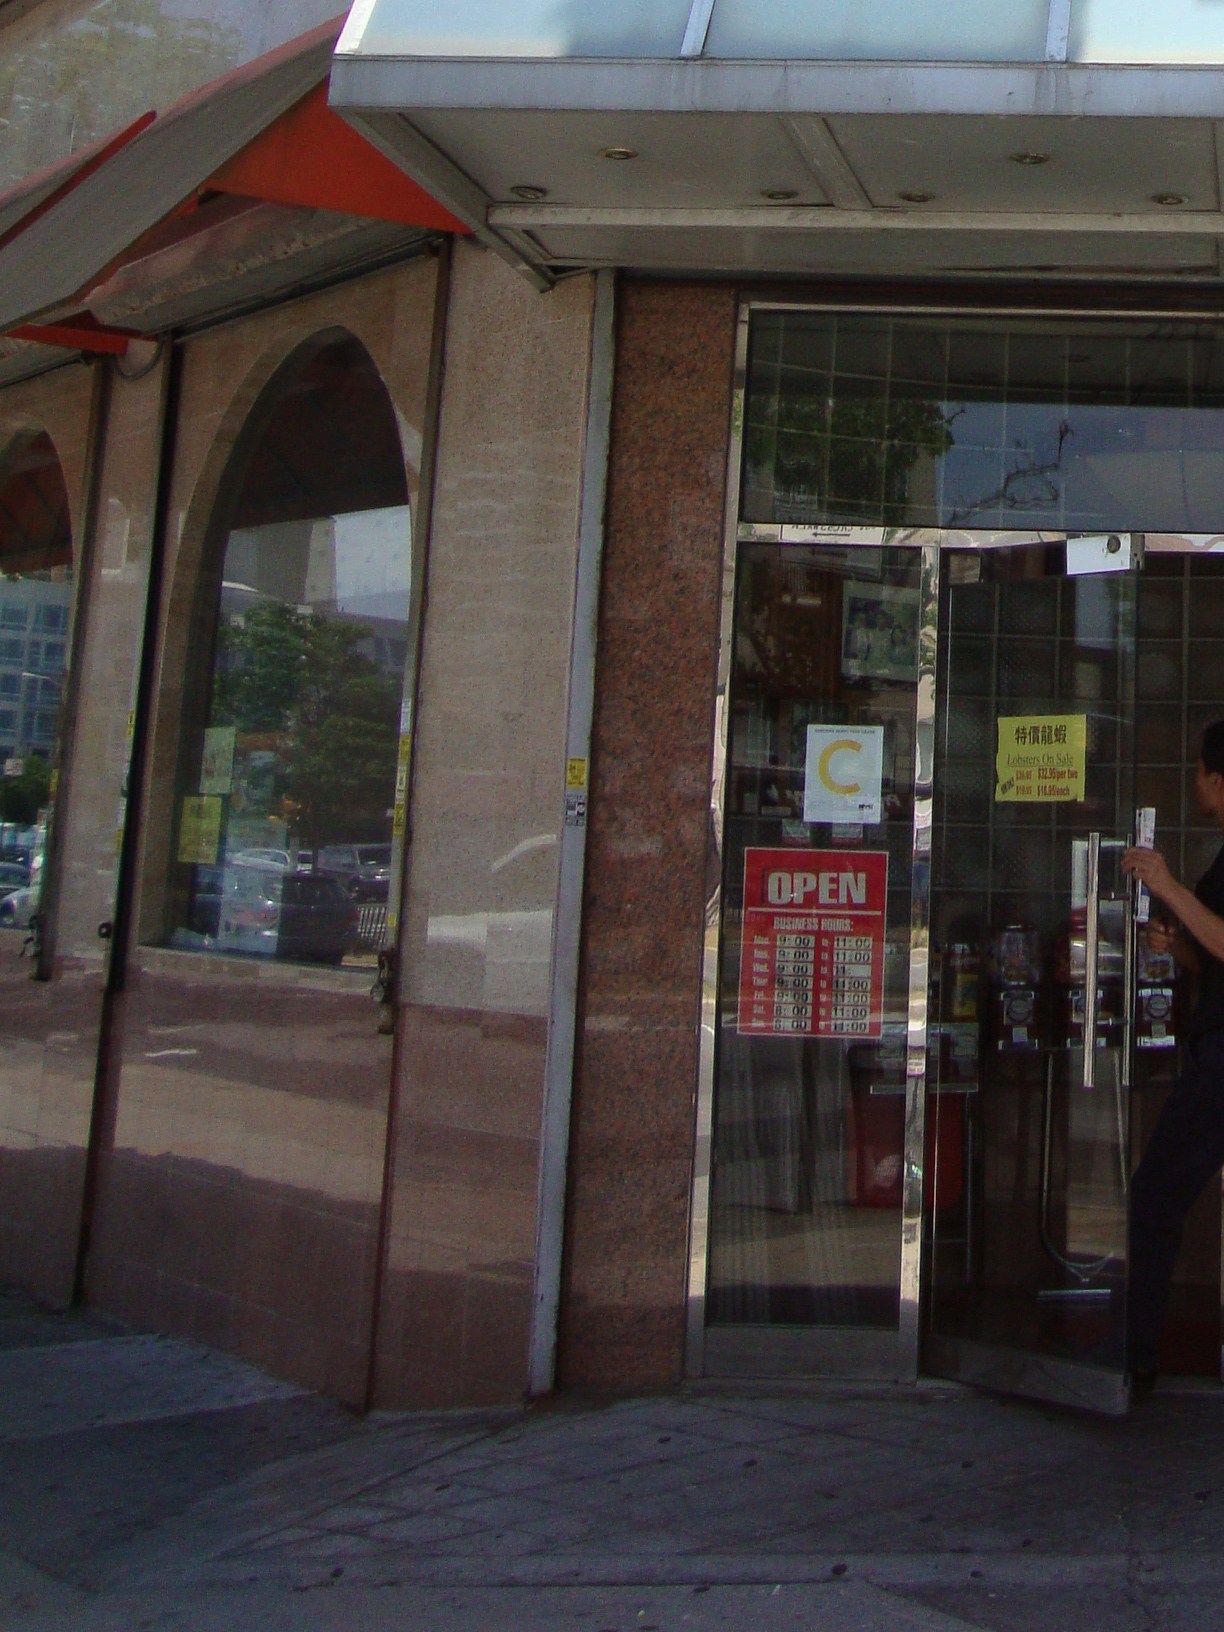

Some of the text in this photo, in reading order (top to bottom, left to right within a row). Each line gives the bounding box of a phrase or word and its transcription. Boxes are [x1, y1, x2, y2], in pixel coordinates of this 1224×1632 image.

[1015, 724, 1067, 745] 特價龍蝦
[818, 739, 862, 796] C
[1042, 754, 1054, 765] On
[1057, 752, 1073, 765] Sale
[768, 872, 866, 905] OPEN
[774, 916, 818, 931] BUSINESS
